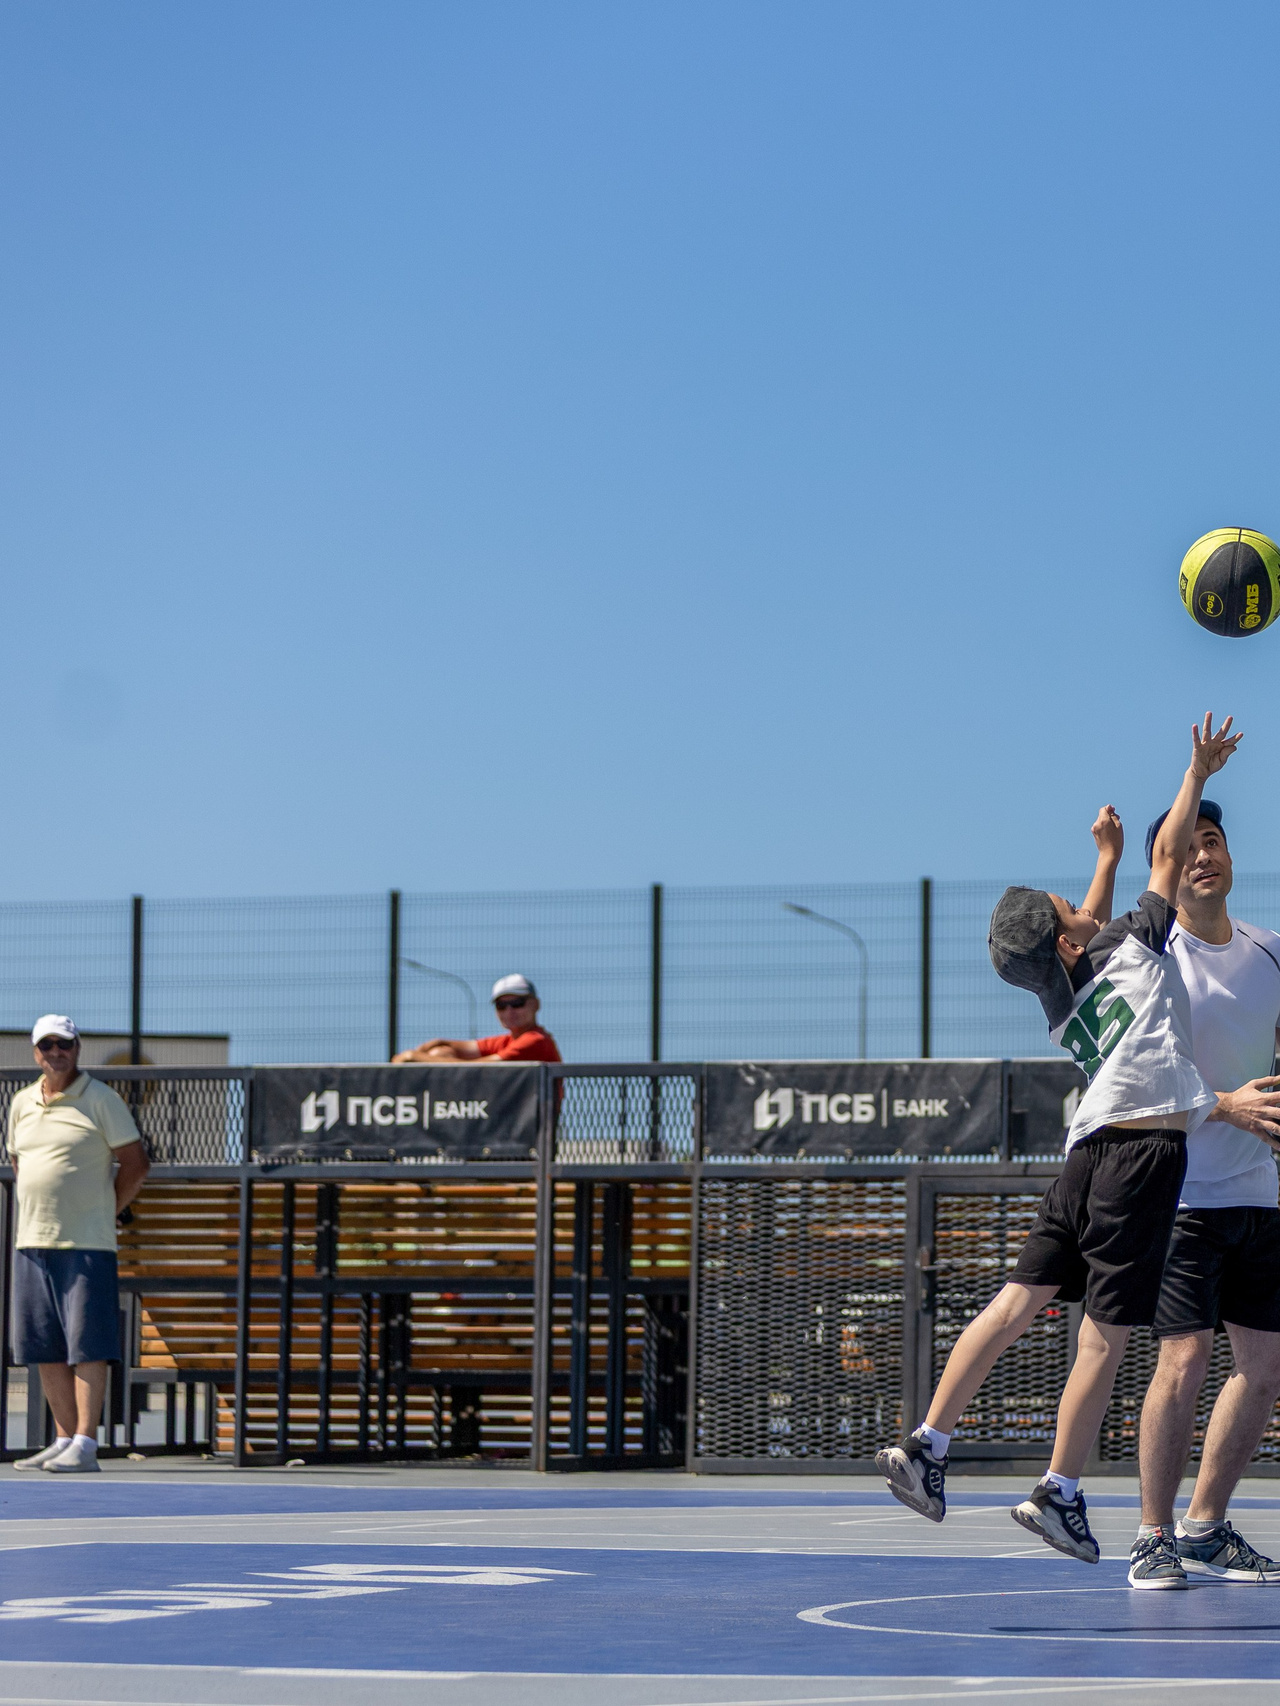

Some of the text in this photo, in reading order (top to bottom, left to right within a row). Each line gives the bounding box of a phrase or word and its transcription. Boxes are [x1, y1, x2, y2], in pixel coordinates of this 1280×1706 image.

[347, 1095, 490, 1126] ПСБ БАНК
[802, 1092, 950, 1124] ПСБ БАНК
